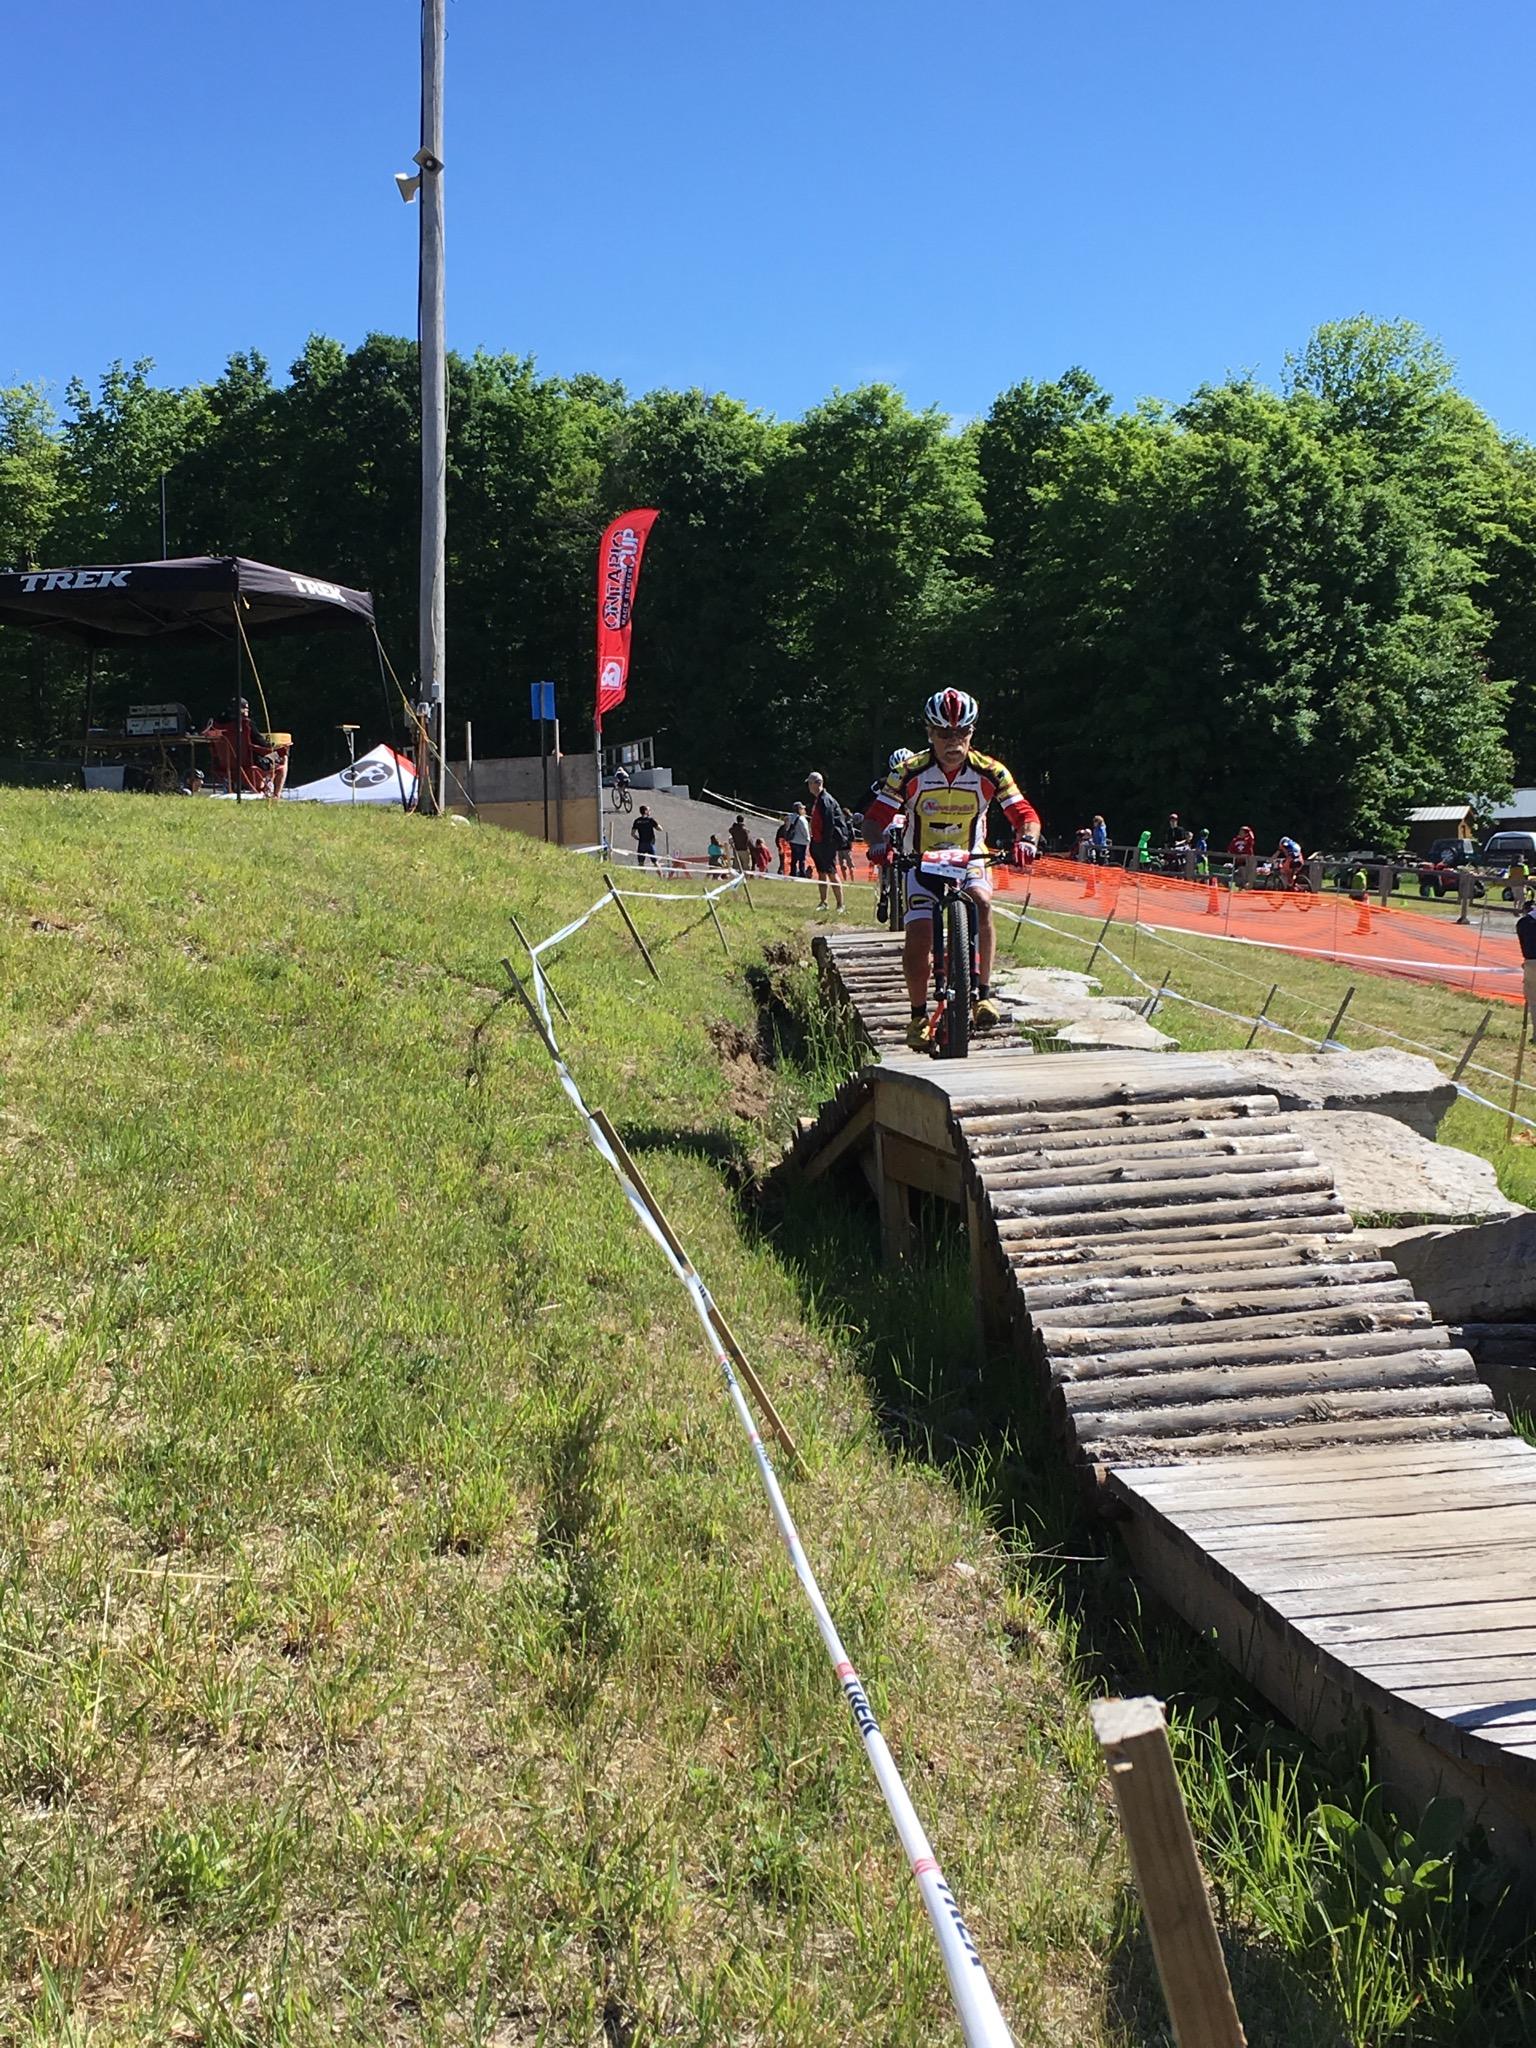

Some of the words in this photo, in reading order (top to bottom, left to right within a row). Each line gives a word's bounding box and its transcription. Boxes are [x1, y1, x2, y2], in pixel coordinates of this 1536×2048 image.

[620, 528, 638, 569] CUP
[20, 570, 132, 592] TREK
[289, 576, 347, 603] TREK
[604, 531, 623, 628] ONTARIO
